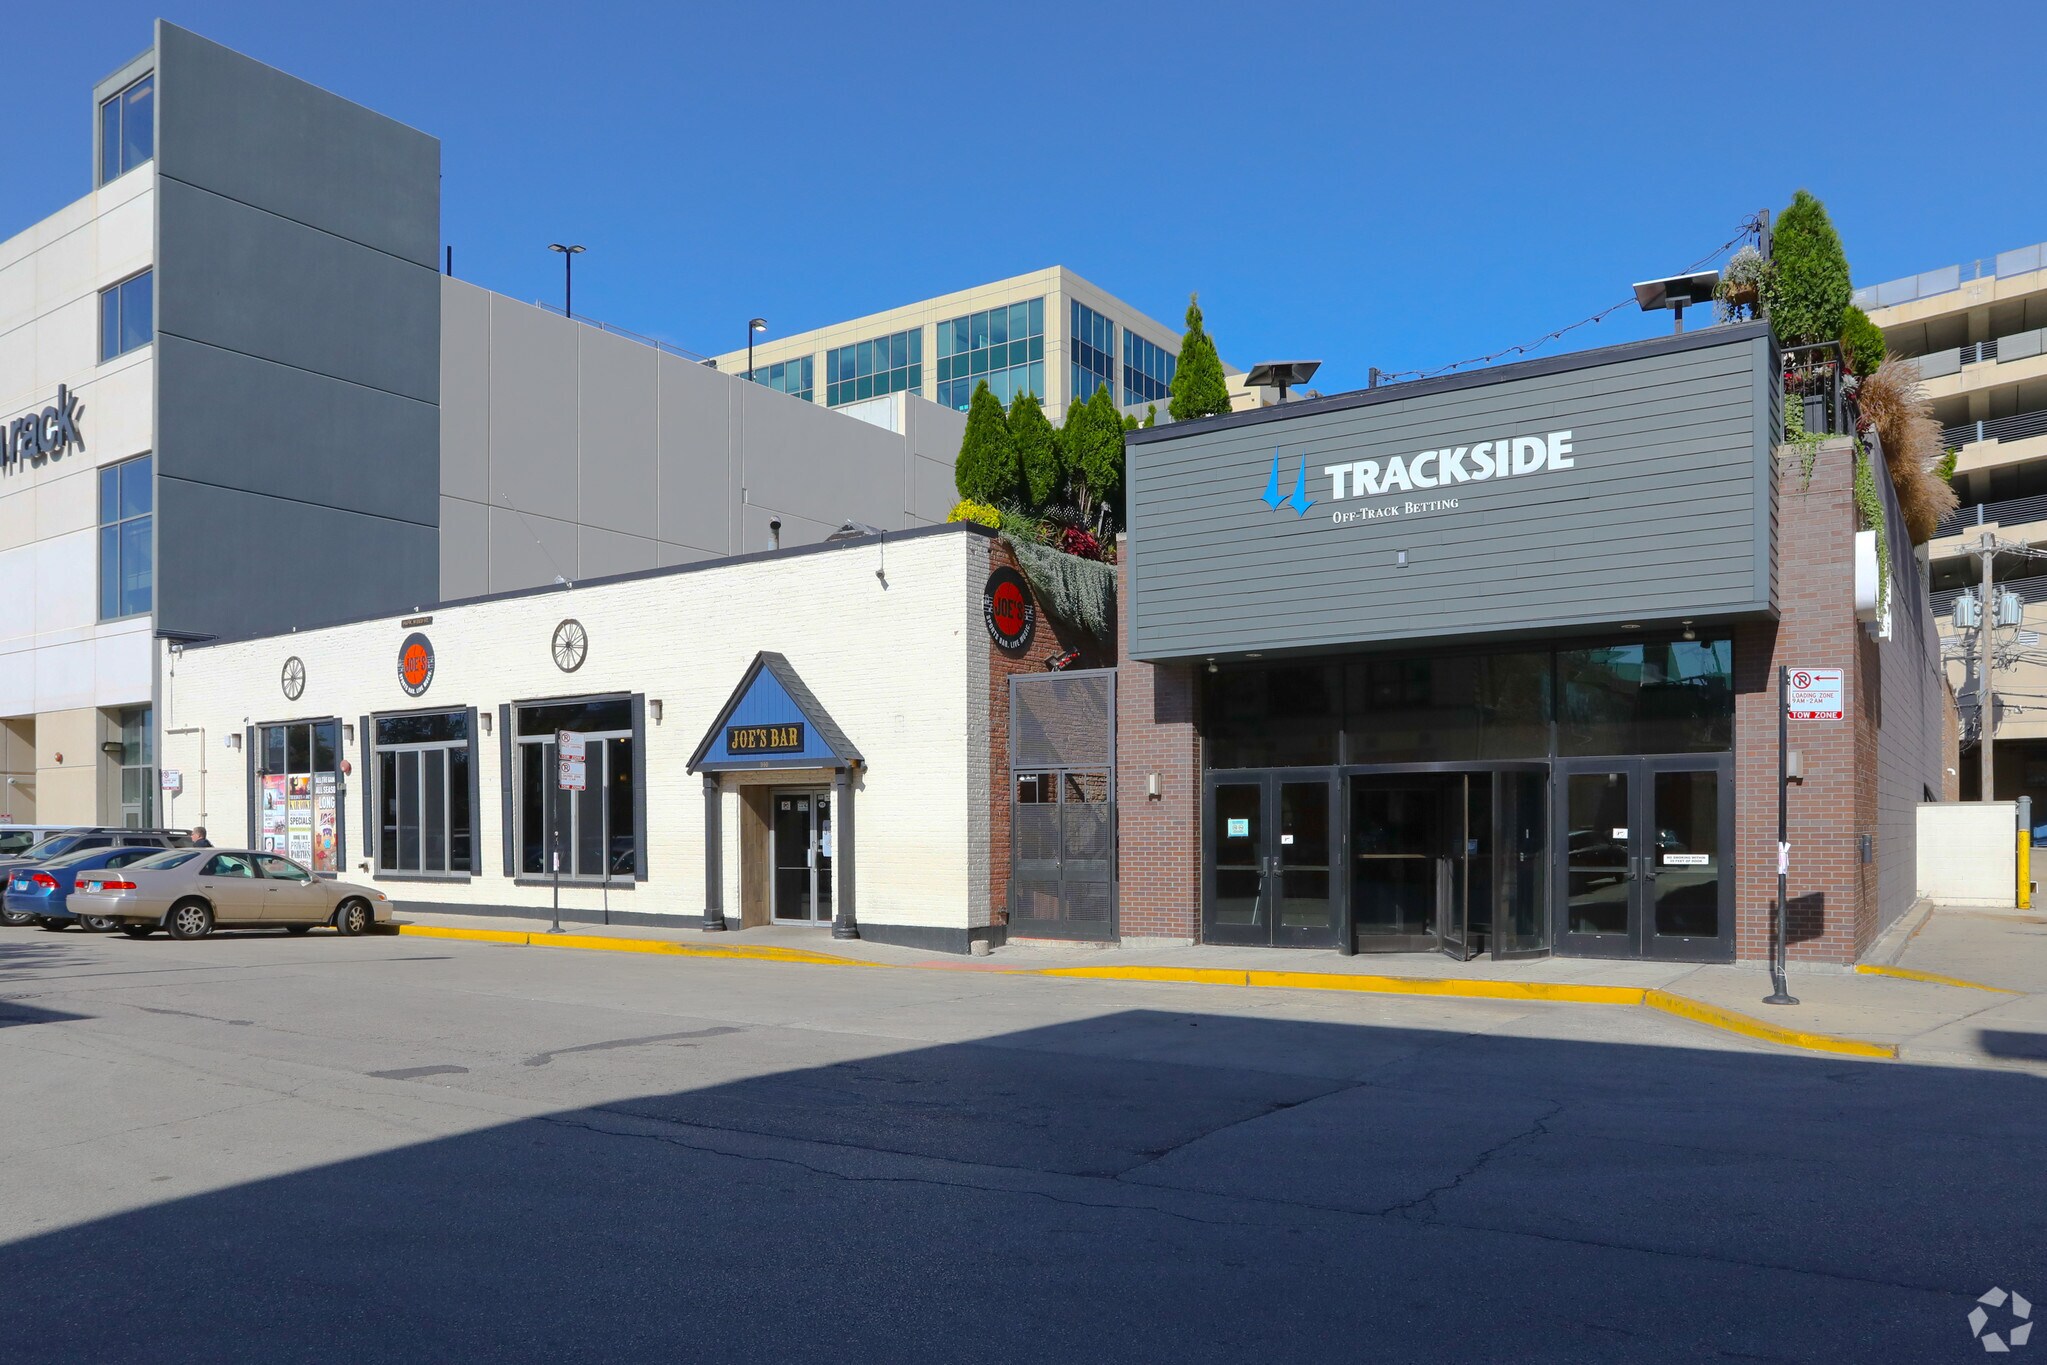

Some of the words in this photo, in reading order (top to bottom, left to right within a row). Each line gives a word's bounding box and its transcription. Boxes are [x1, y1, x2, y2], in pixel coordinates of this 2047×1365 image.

[10, 383, 79, 464] rack
[1324, 430, 1575, 500] TRACKSIDE
[994, 597, 1025, 620] JOE'S
[985, 614, 1000, 640] SPORTS
[1010, 639, 1021, 649] LIVE
[404, 655, 428, 673] JOE'S
[1792, 711, 1811, 719] TOW
[1814, 711, 1838, 719] ZONE
[731, 728, 767, 749] JOE'S
[770, 727, 798, 747] BAR
[323, 785, 336, 794] SEASO
[319, 796, 336, 809] LONG
[290, 817, 312, 825] SPECIALS
[290, 841, 311, 850] PRIVATE
